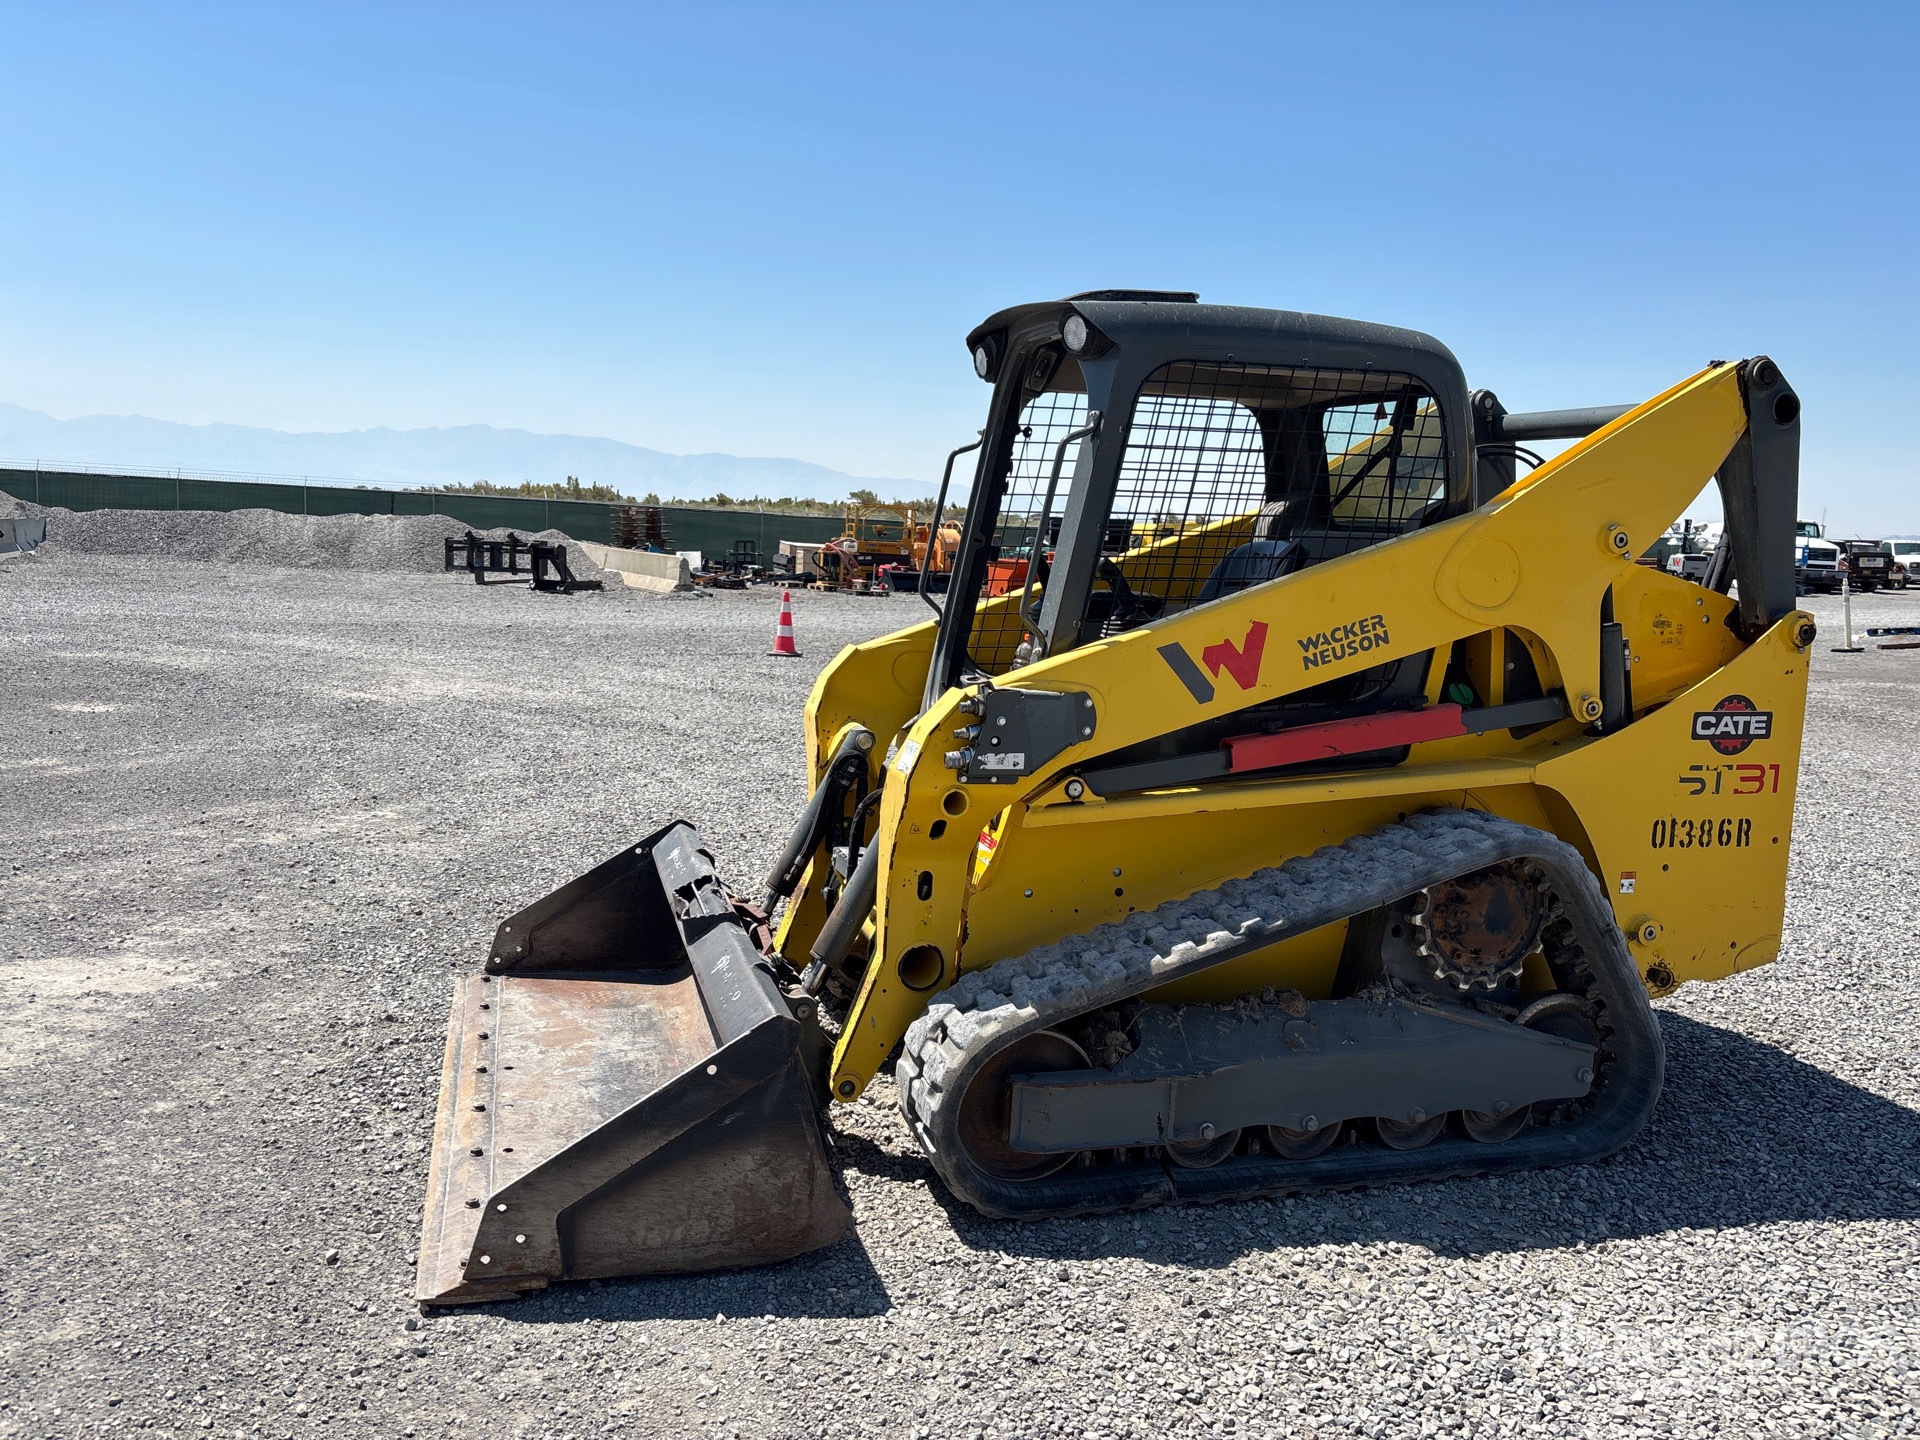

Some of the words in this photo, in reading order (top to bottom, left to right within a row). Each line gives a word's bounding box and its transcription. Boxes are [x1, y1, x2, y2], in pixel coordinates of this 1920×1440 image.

[1297, 614, 1387, 653] WACKER
[1302, 630, 1390, 671] NEUSON
[1695, 715, 1768, 736] CATE
[1678, 763, 1781, 796] ST31
[1651, 817, 1752, 849] 01386R
